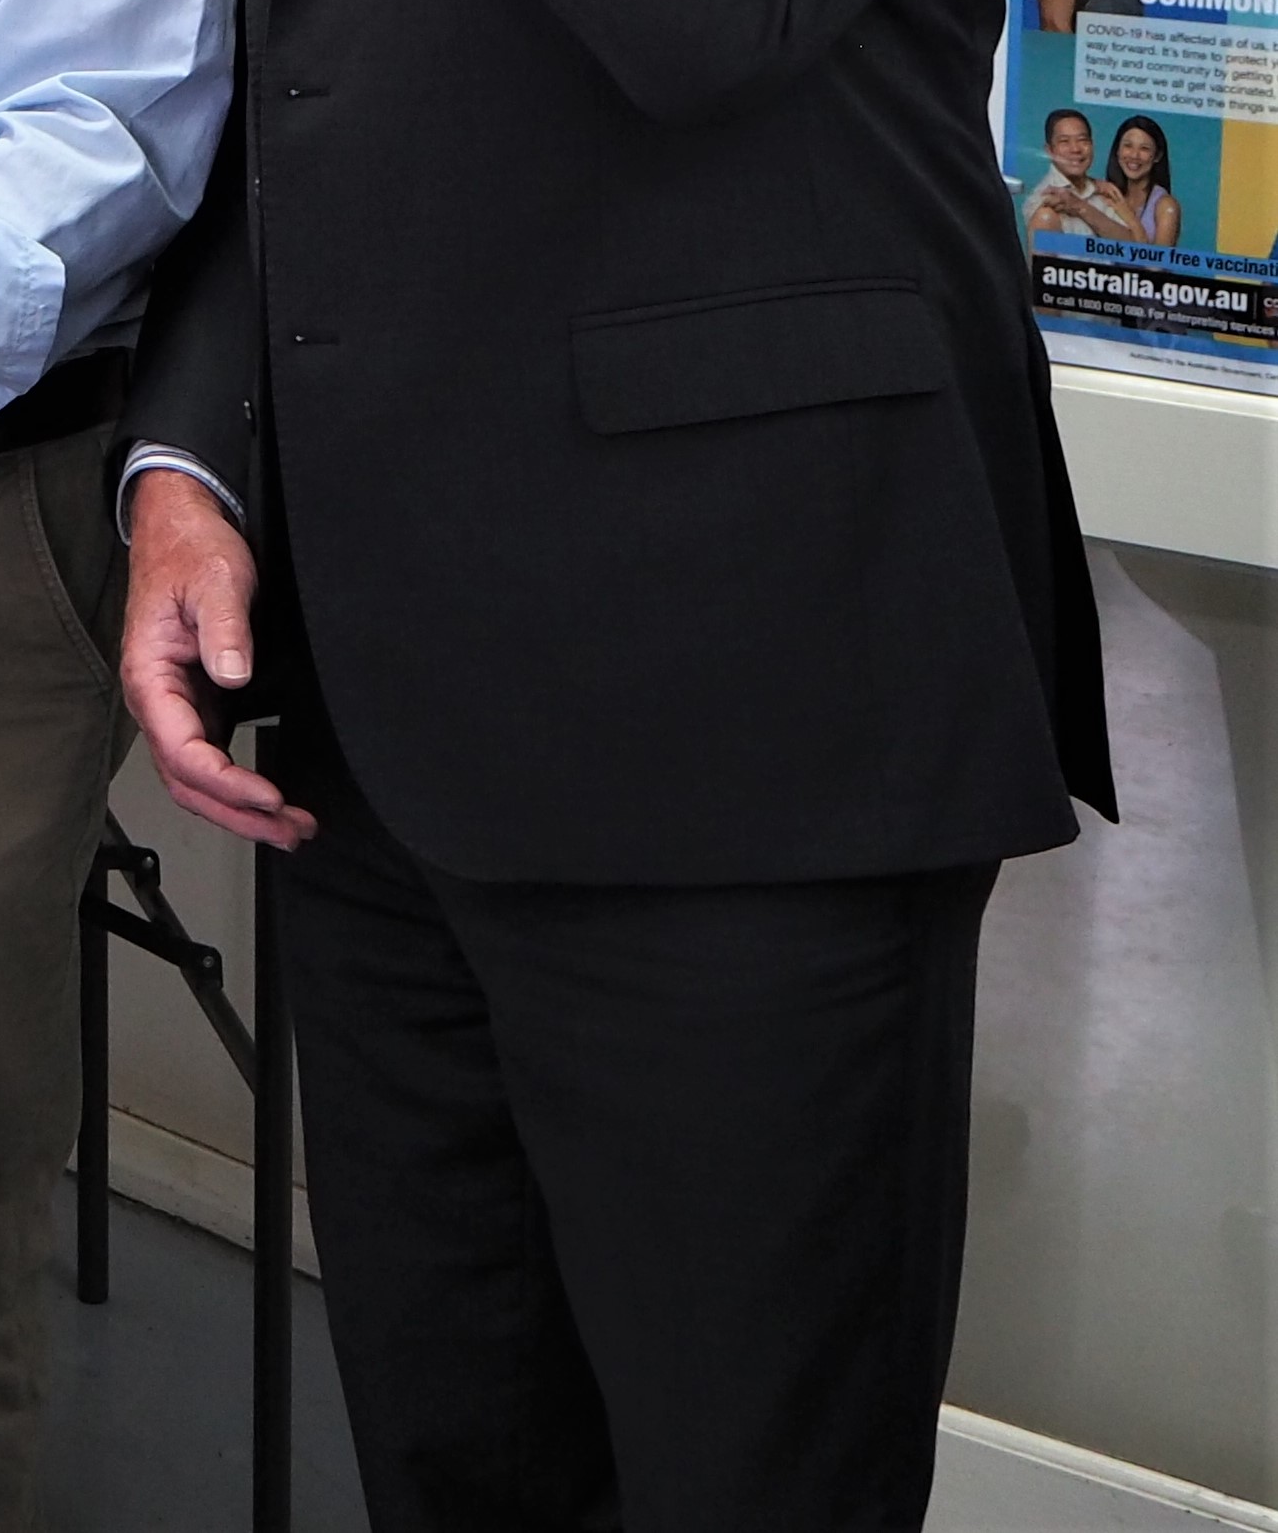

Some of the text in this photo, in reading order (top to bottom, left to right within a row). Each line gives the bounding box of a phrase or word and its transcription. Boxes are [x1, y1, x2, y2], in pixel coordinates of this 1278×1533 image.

[1086, 23, 1142, 38] COVID-19
[1145, 29, 1166, 41] has
[1170, 31, 1216, 46] affected
[1220, 37, 1232, 47] all
[1236, 39, 1248, 49] of
[1086, 41, 1268, 66] way forward. time to protect
[1085, 54, 1273, 84] family and community by getting
[1085, 68, 1106, 81] The
[1109, 73, 1148, 85] sooner
[1152, 78, 1168, 87] we
[1171, 78, 1185, 89] all
[1188, 81, 1206, 92] get
[1084, 86, 1265, 114] we get back to doing the things
[1085, 238, 1124, 257] Book
[1130, 246, 1165, 262] your
[1170, 248, 1200, 267] free
[1043, 266, 1248, 312] australia.gov.au
[1043, 293, 1055, 304] Or
[1056, 294, 1075, 307] call
[1077, 298, 1102, 312] 1800
[1104, 301, 1123, 314] 020
[1148, 306, 1166, 319] For
[1167, 309, 1228, 331] interpreting
[1230, 321, 1275, 336] services
